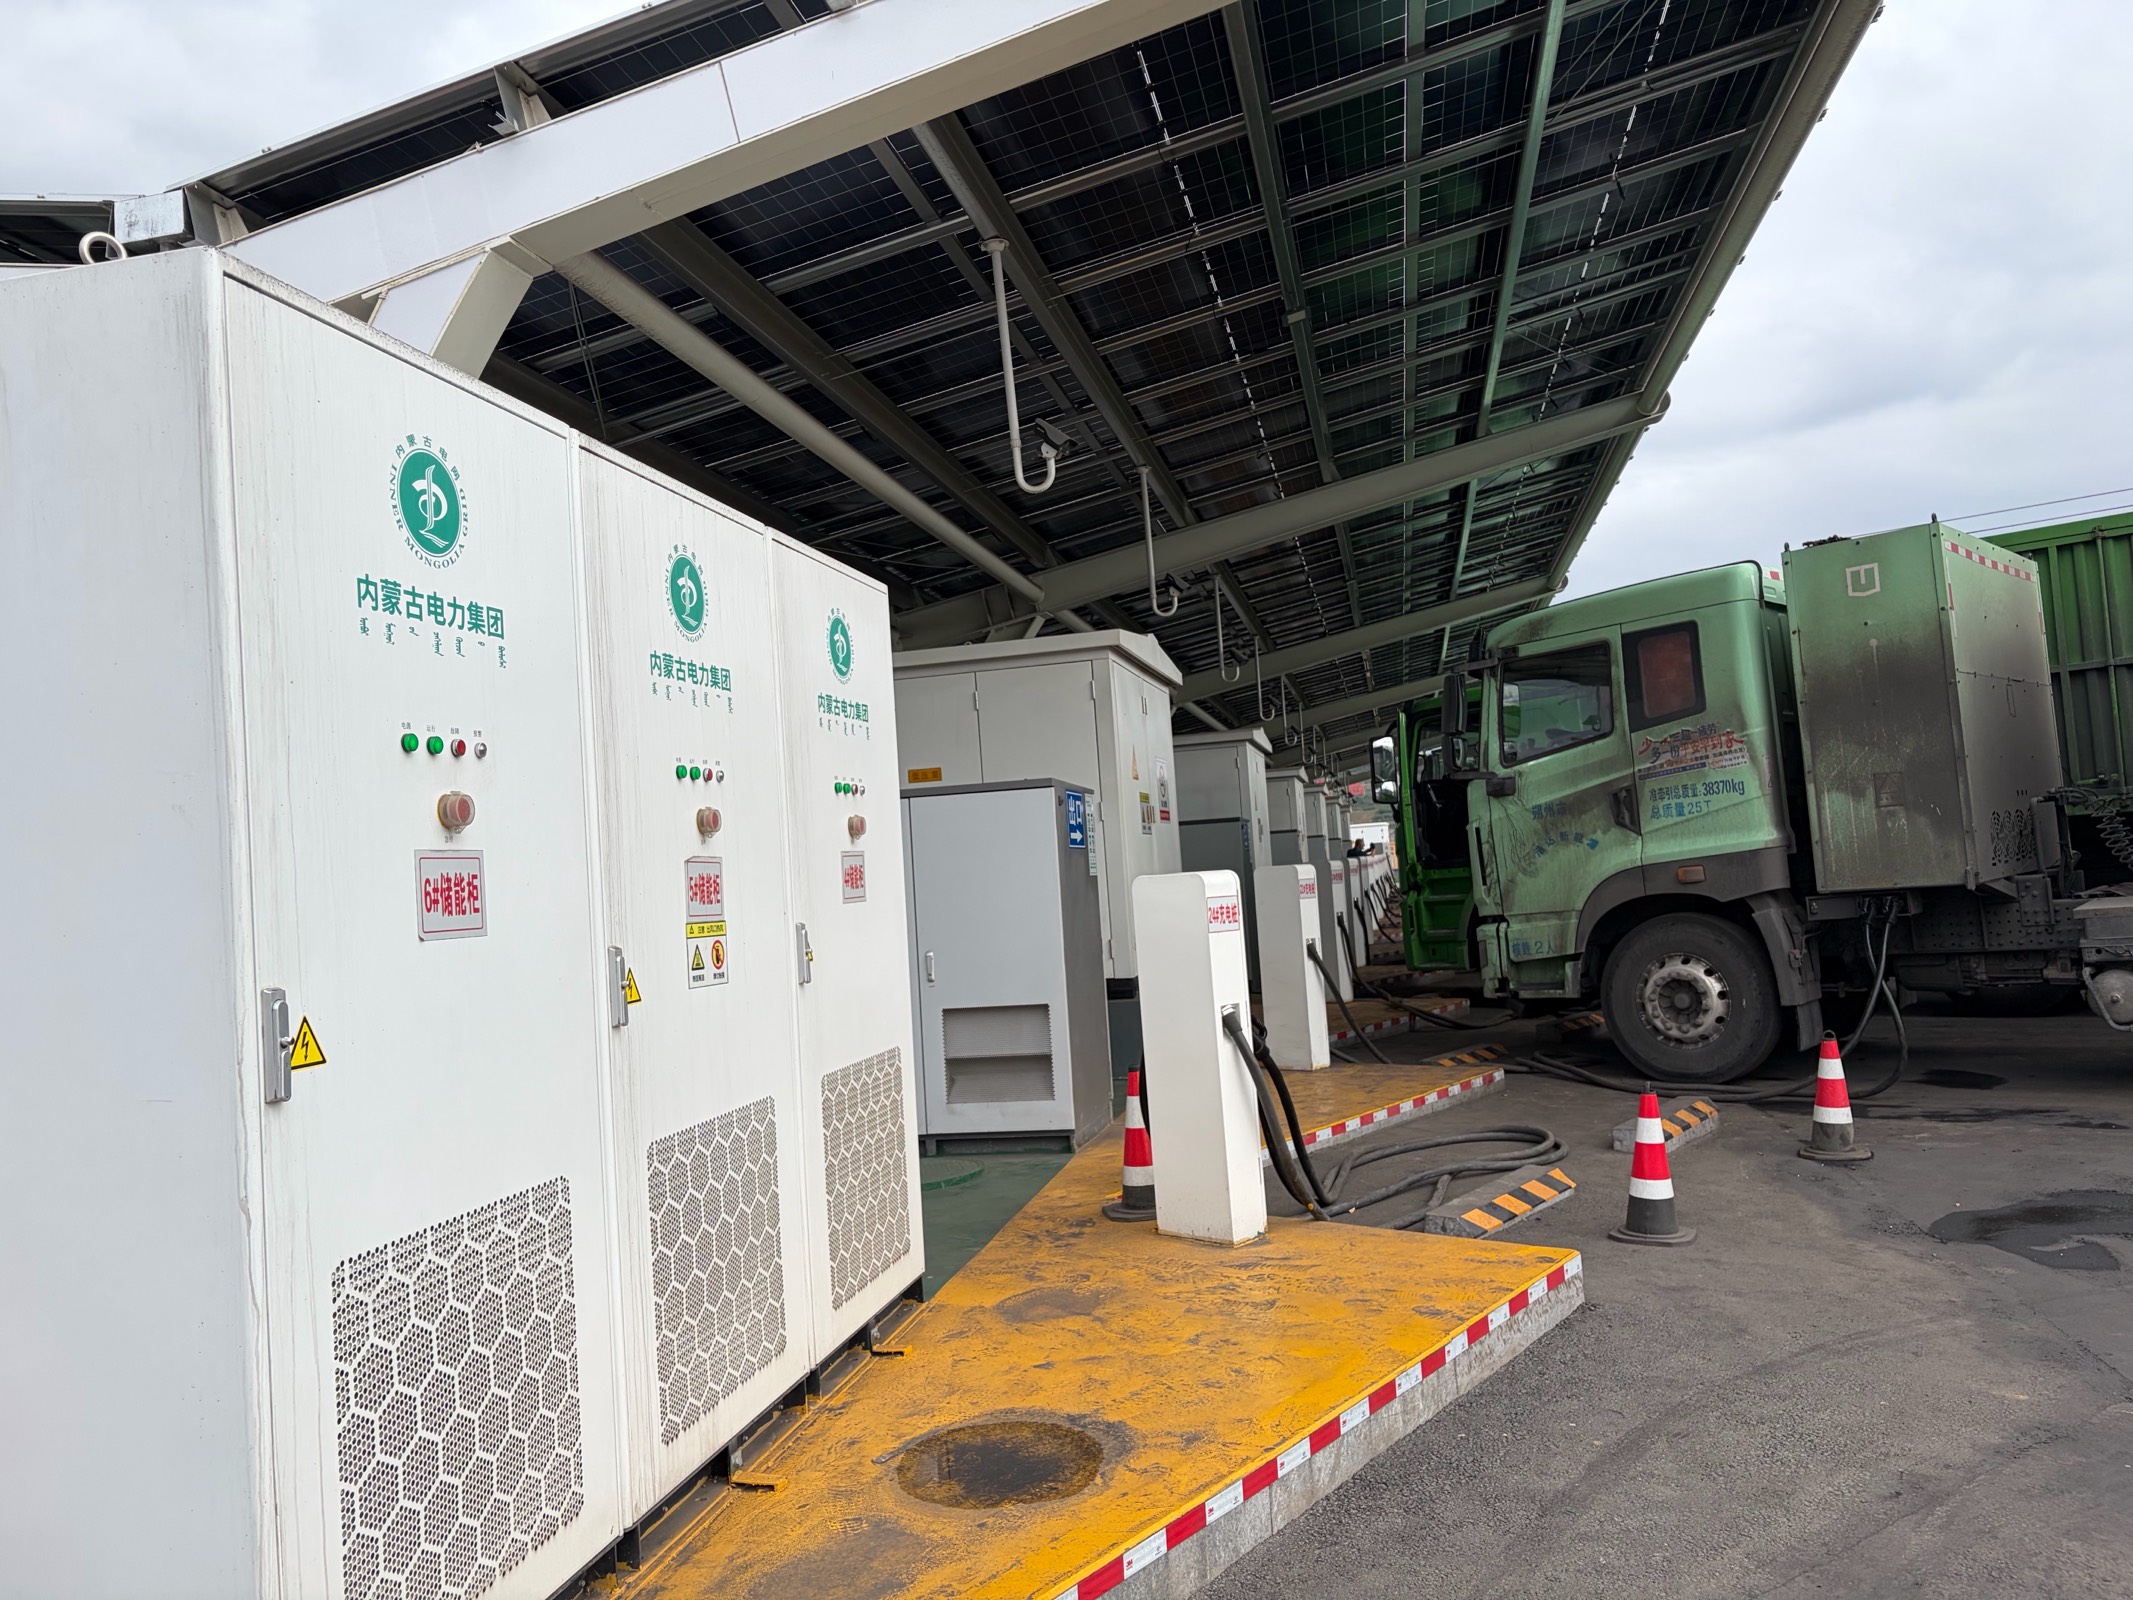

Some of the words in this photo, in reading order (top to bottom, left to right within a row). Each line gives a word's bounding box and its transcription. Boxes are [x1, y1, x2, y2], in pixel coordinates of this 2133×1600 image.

[395, 434, 461, 481] 内蒙古电网
[389, 464, 404, 531] INNER
[404, 537, 465, 569] MONGOLIA
[459, 488, 469, 537] GRID
[356, 573, 505, 640] 内蒙古电力集团
[650, 649, 732, 692] 内蒙古电力集团
[817, 692, 869, 723] 内蒙古电力集团
[1068, 795, 1083, 826] 出口
[424, 872, 480, 917] 6#储能柜
[689, 872, 721, 905] 5#储能柜
[1208, 903, 1238, 924] 24#充电桩
